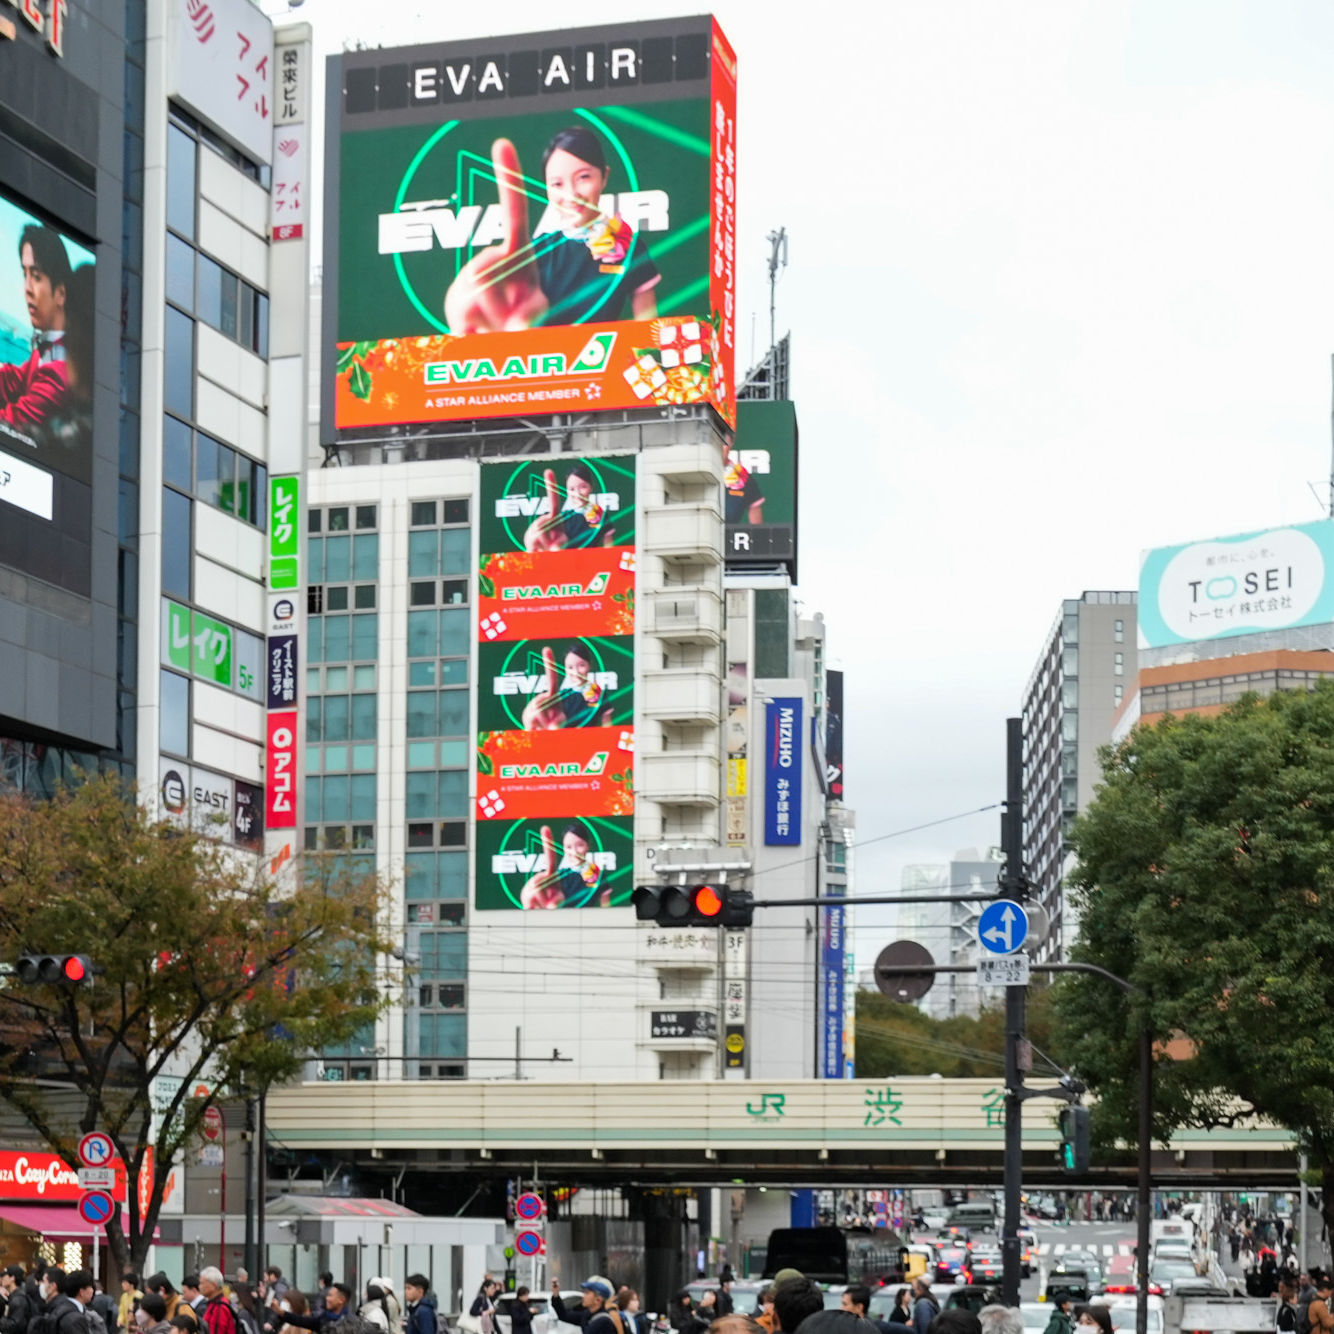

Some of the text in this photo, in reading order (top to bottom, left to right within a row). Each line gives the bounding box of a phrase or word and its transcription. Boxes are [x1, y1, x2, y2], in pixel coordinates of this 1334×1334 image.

[414, 47, 636, 99] EVA AIR
[279, 226, 294, 239] 8F
[425, 388, 580, 408] A STAR ALLIANCE MEMBER
[274, 486, 293, 544] レイク
[1188, 566, 1292, 603] TOSEI
[1189, 596, 1292, 622] トーセイ株式会社
[172, 613, 228, 665] レイク
[239, 665, 254, 692] 5F
[272, 752, 292, 812] アコム
[776, 707, 794, 836] MIZUHO みずほ銀行
[194, 787, 229, 809] EAST
[236, 806, 253, 834] 4F
[746, 1094, 786, 1116] JR
[15, 1157, 50, 1193] Cozy
